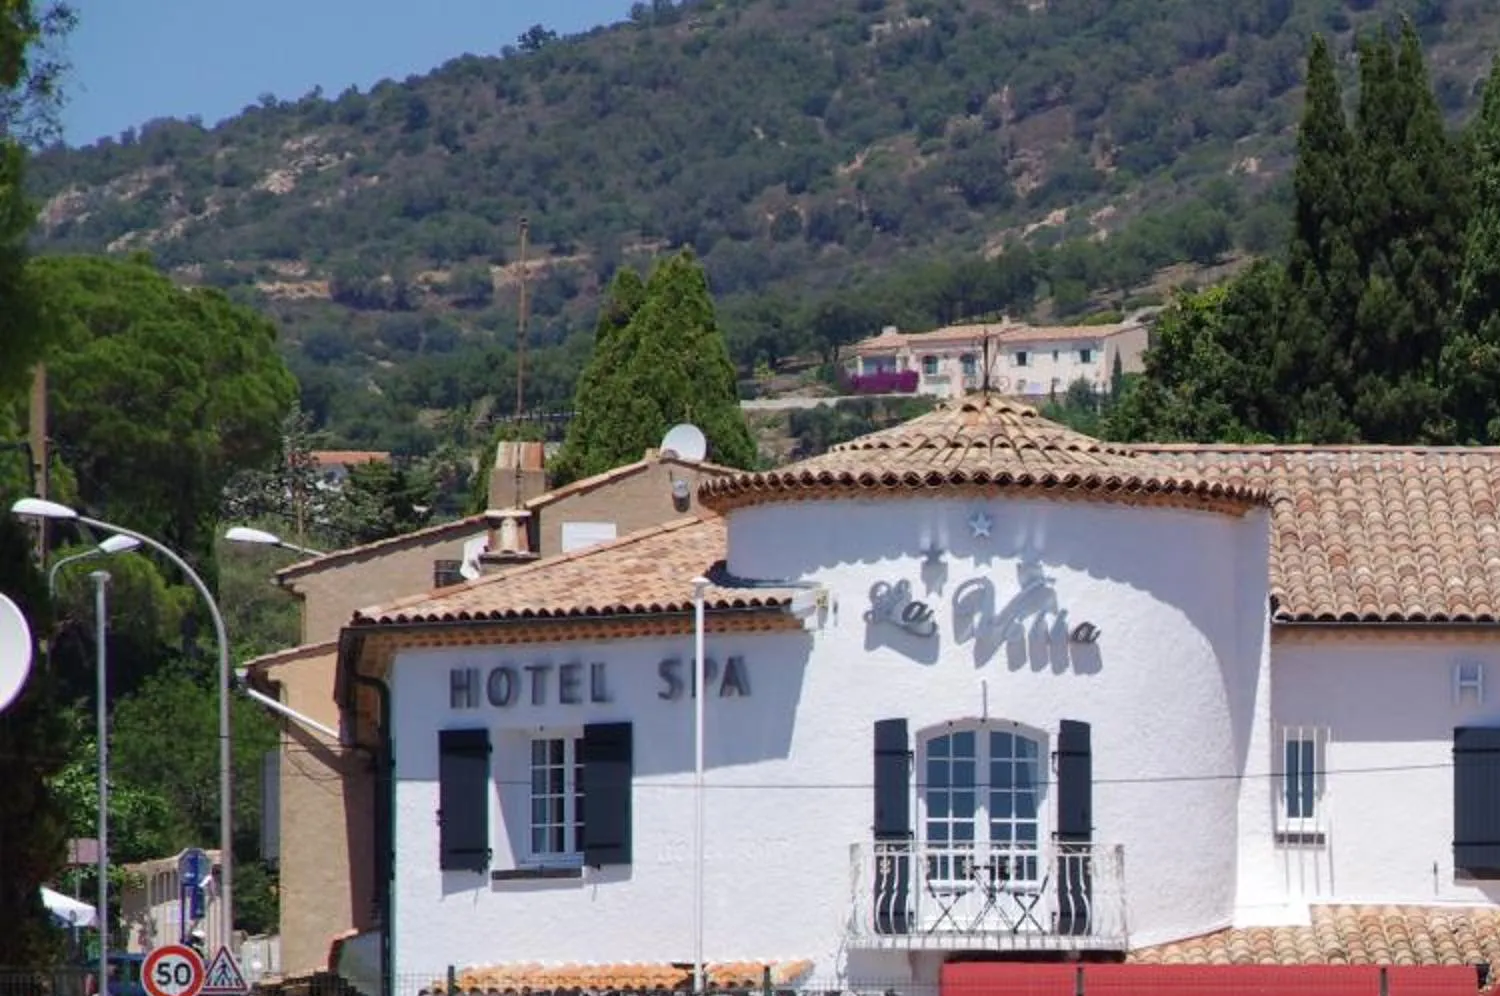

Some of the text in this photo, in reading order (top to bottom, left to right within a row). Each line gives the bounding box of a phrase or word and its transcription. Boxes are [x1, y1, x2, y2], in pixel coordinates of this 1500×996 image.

[863, 576, 1102, 652] La Villa
[450, 656, 750, 709] HOTEL SPA
[156, 962, 191, 987] 50
